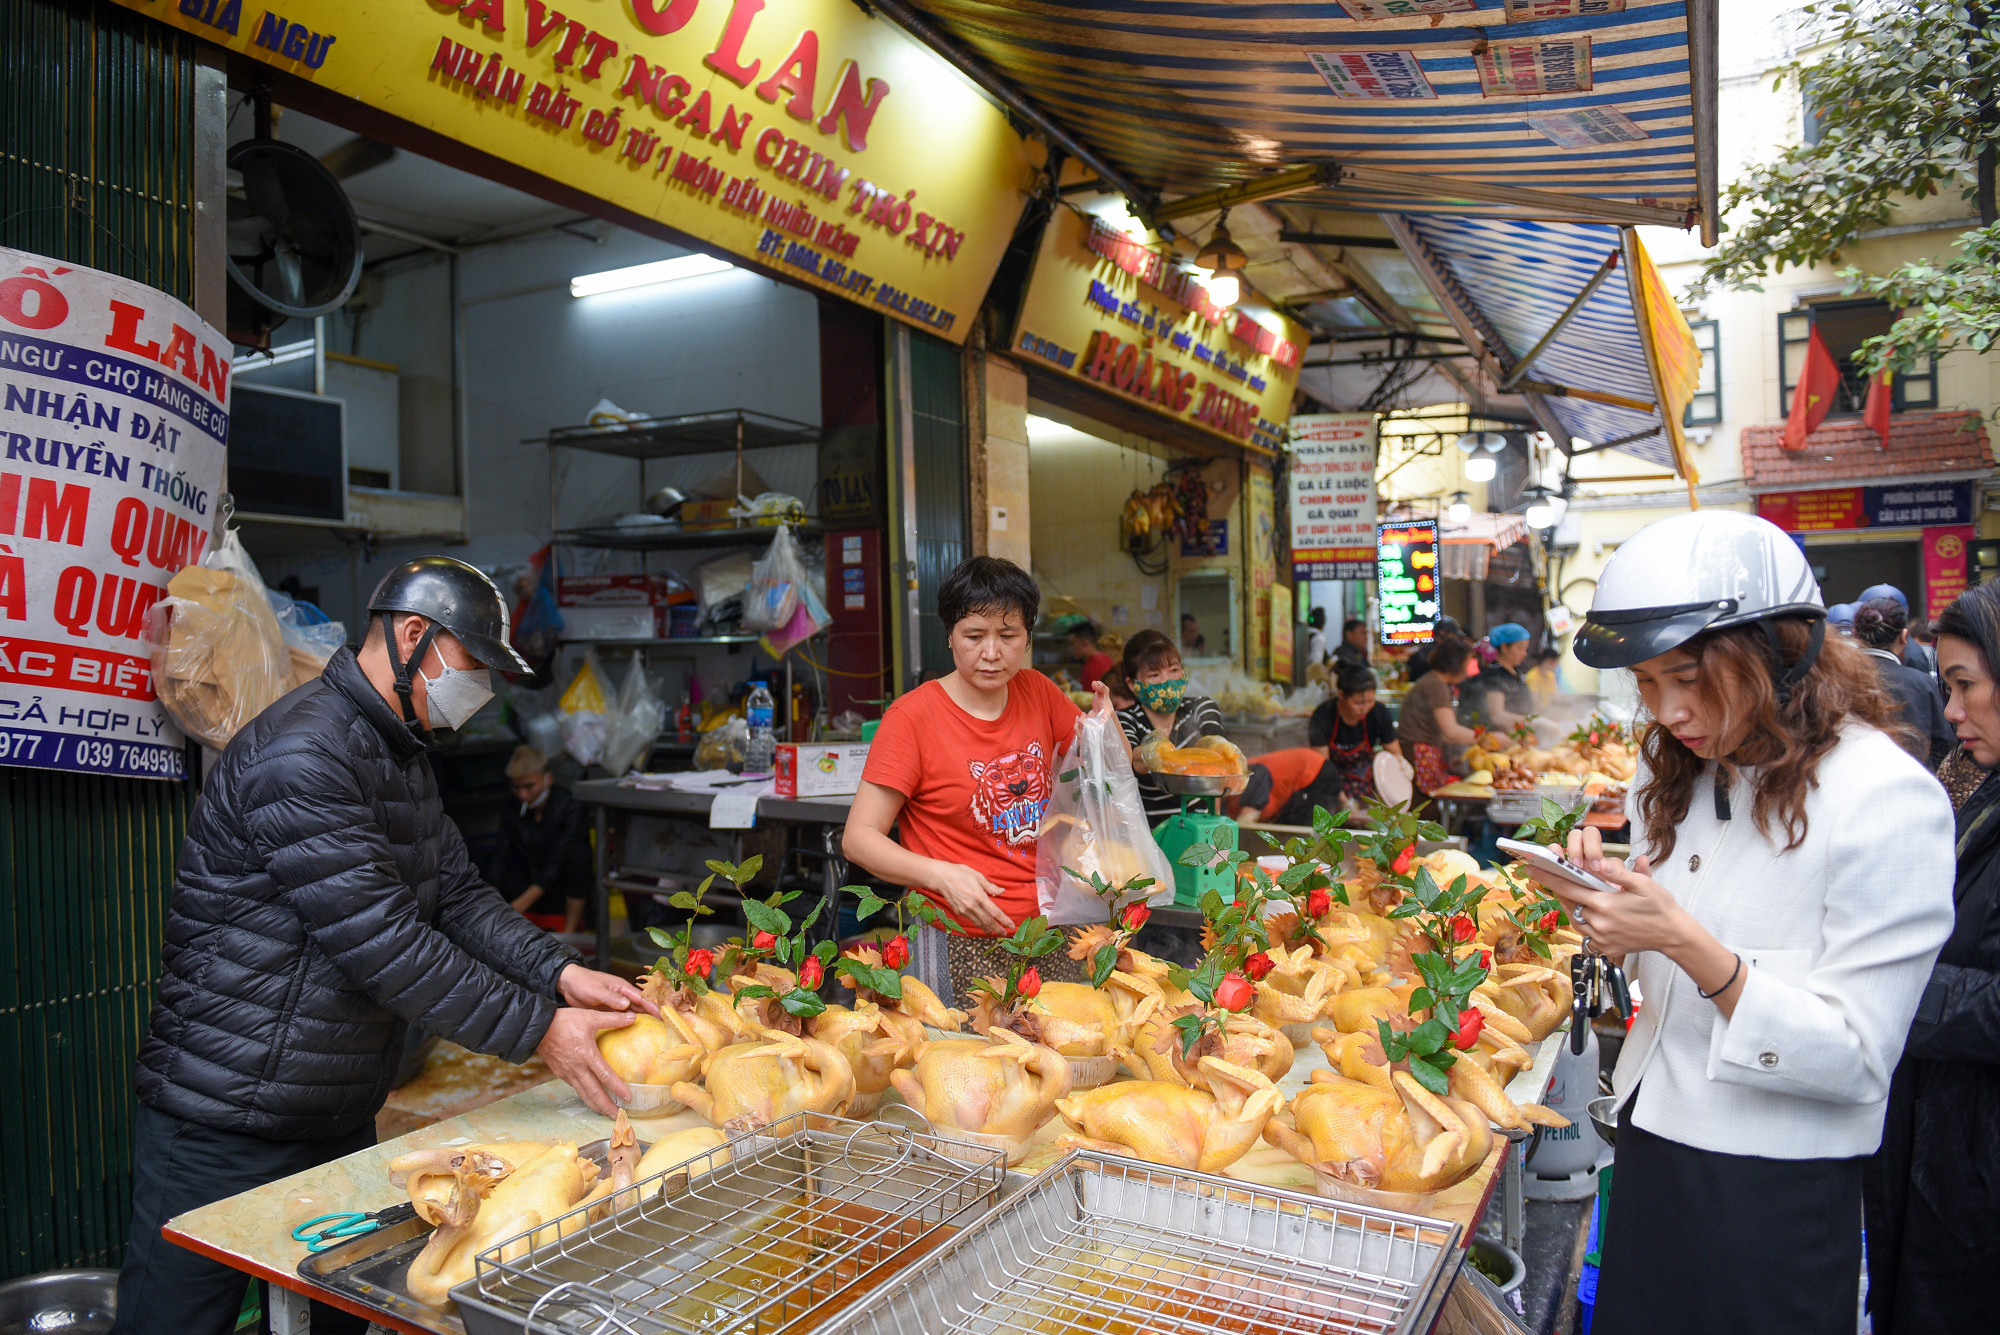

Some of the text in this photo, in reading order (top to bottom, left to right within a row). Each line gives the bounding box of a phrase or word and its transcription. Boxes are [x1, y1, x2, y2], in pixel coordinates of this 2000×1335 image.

[254, 10, 337, 70] NGƯ
[525, 0, 618, 80] VỊT
[619, 53, 752, 150] NGAN
[756, 126, 850, 201] CHIM
[706, 0, 889, 152] LAN
[430, 35, 526, 105] NHẬN
[656, 143, 674, 173] 1
[671, 151, 726, 197] MÓN
[720, 175, 766, 217] ĐẾN
[1, 340, 64, 372] NGƯ
[85, 360, 141, 393] CHỢ
[144, 378, 190, 415] HÀNG
[104, 299, 230, 405] LAN
[1089, 330, 1197, 412] HOÀNG
[3, 383, 182, 454] NHẬN ĐẶT
[139, 460, 208, 515] THỐNG
[1299, 493, 1368, 506] CHIM QUAY
[1328, 508, 1360, 520] QUAY
[110, 496, 208, 574] QUAY
[70, 658, 155, 697] BIỆT
[59, 706, 130, 736] HỢP
[136, 713, 165, 737] LÝ
[76, 740, 114, 768] 039
[119, 744, 183, 775] 7649515
[992, 799, 1049, 832] KENZO
[1544, 1121, 1581, 1140] PETROL
